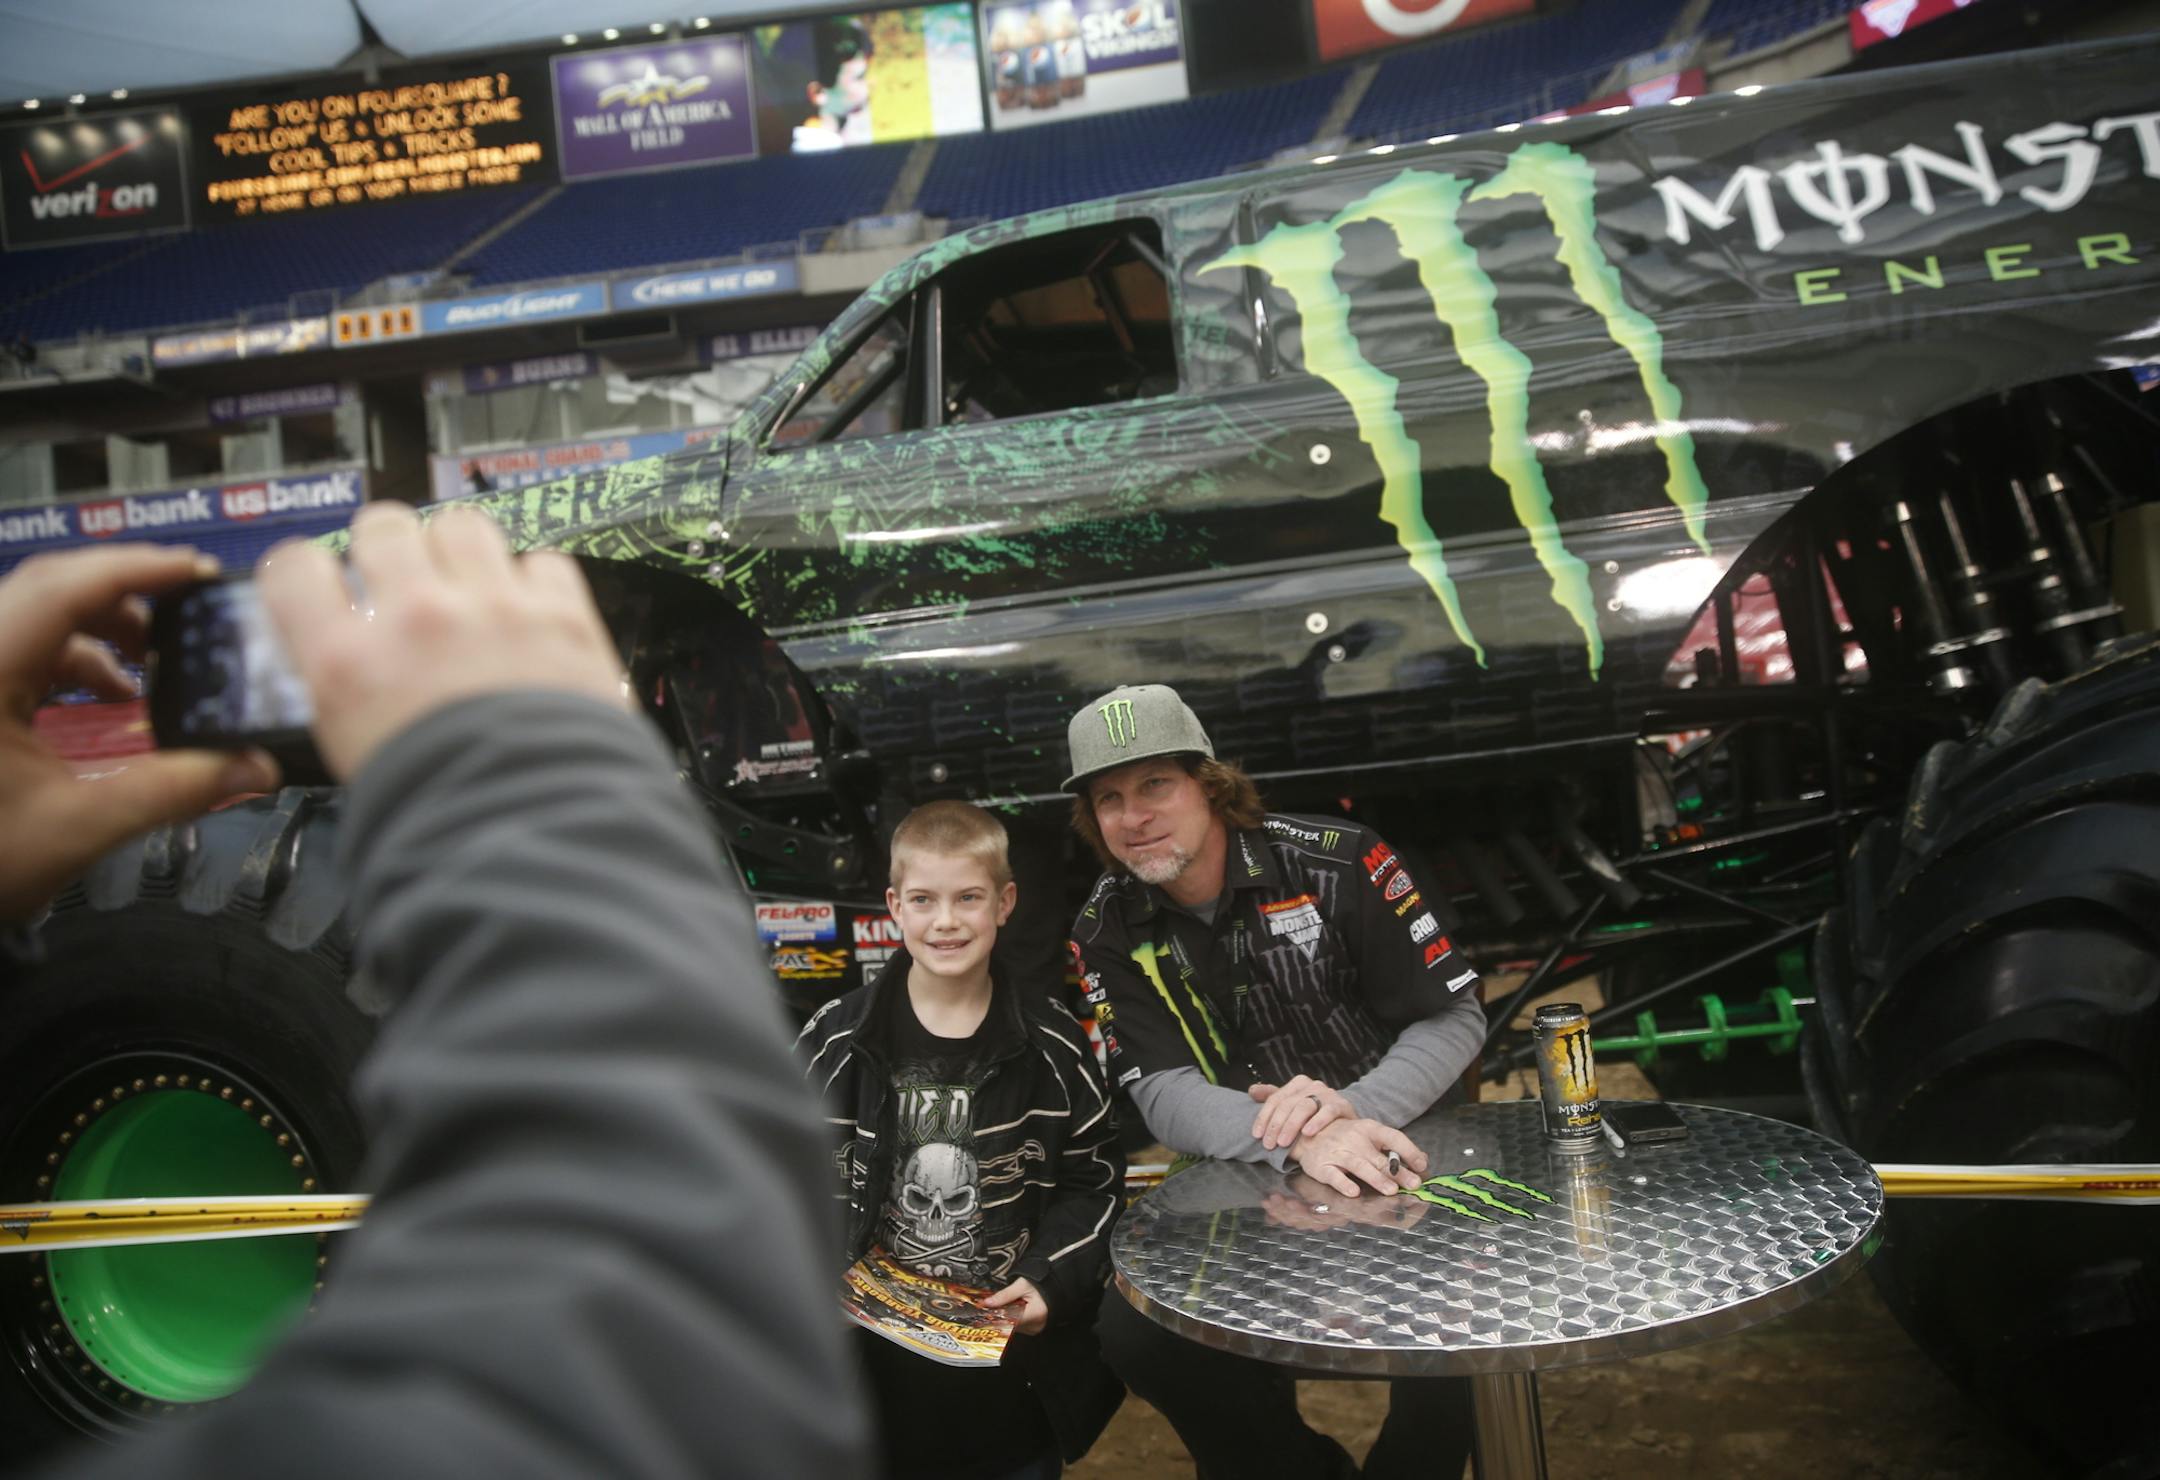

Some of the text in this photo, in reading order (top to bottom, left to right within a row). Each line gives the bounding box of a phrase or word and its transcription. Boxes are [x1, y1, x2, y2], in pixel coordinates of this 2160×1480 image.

[229, 104, 270, 129] ARE
[272, 98, 320, 125] YOU
[322, 95, 356, 119] ON
[358, 75, 495, 115] FOURSQUARE
[319, 118, 350, 144] US
[373, 103, 460, 137] UNLOCK
[463, 96, 522, 127] SOME
[573, 99, 732, 137] MALL OF AMERICA
[269, 126, 478, 175] COOL TIPS TRICKS
[629, 126, 685, 152] FIELD
[31, 181, 158, 219] verizon
[852, 1276, 922, 1320] YEARBOOK
